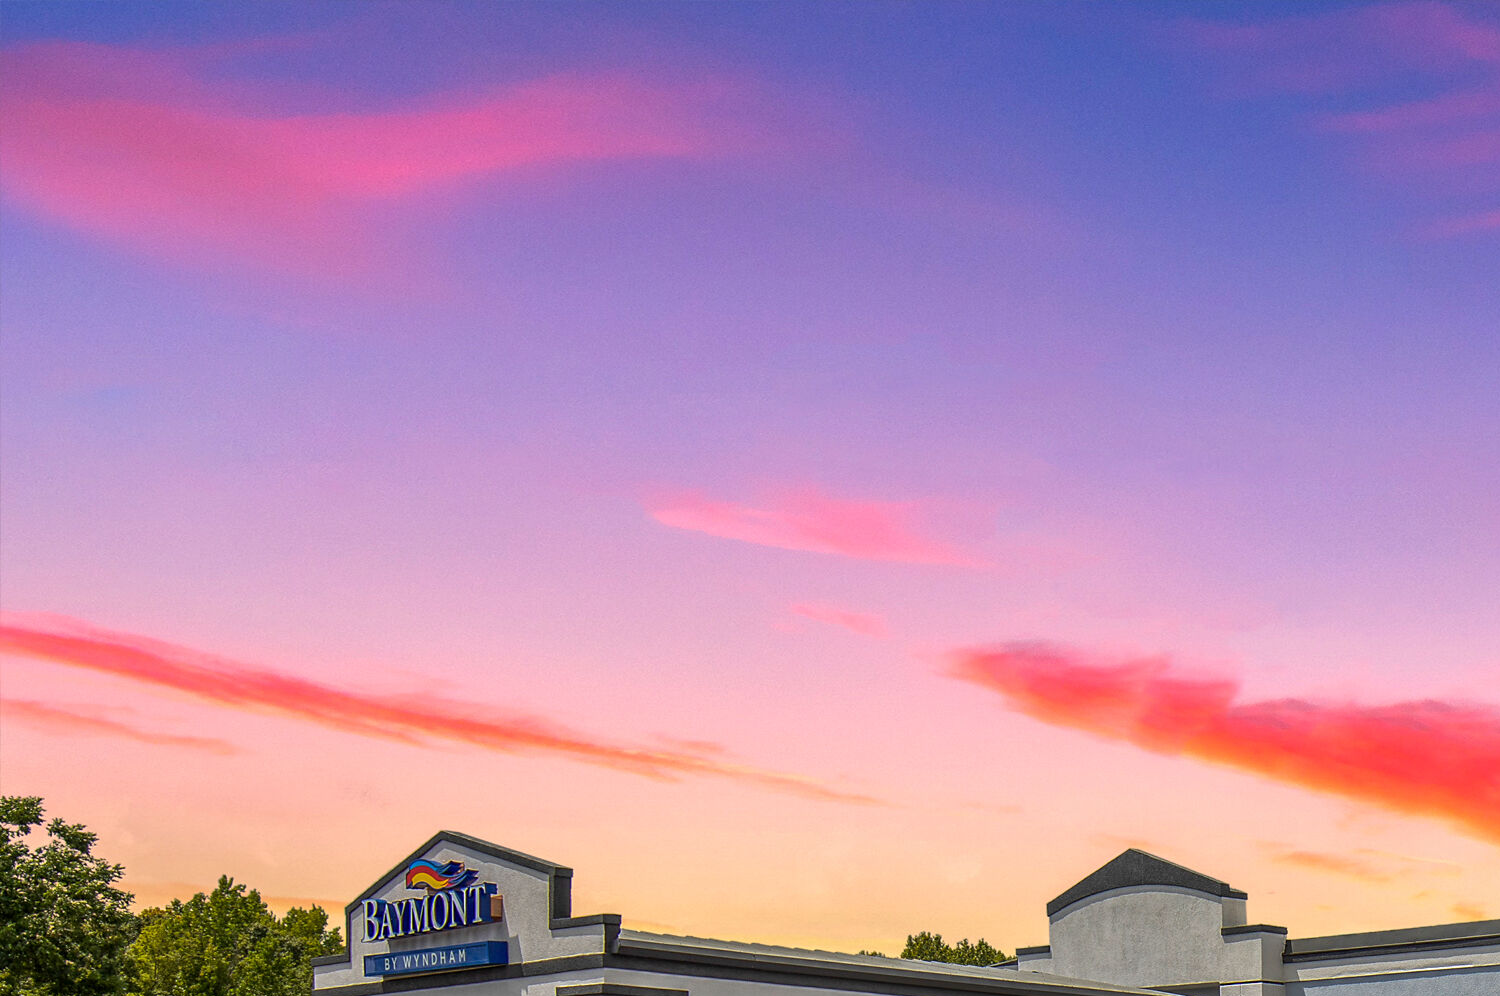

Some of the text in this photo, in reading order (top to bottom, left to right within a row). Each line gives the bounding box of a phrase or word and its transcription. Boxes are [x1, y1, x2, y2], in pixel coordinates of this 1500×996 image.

[361, 884, 487, 942] BAYMONT
[384, 949, 466, 971] BY WYNDHAM
